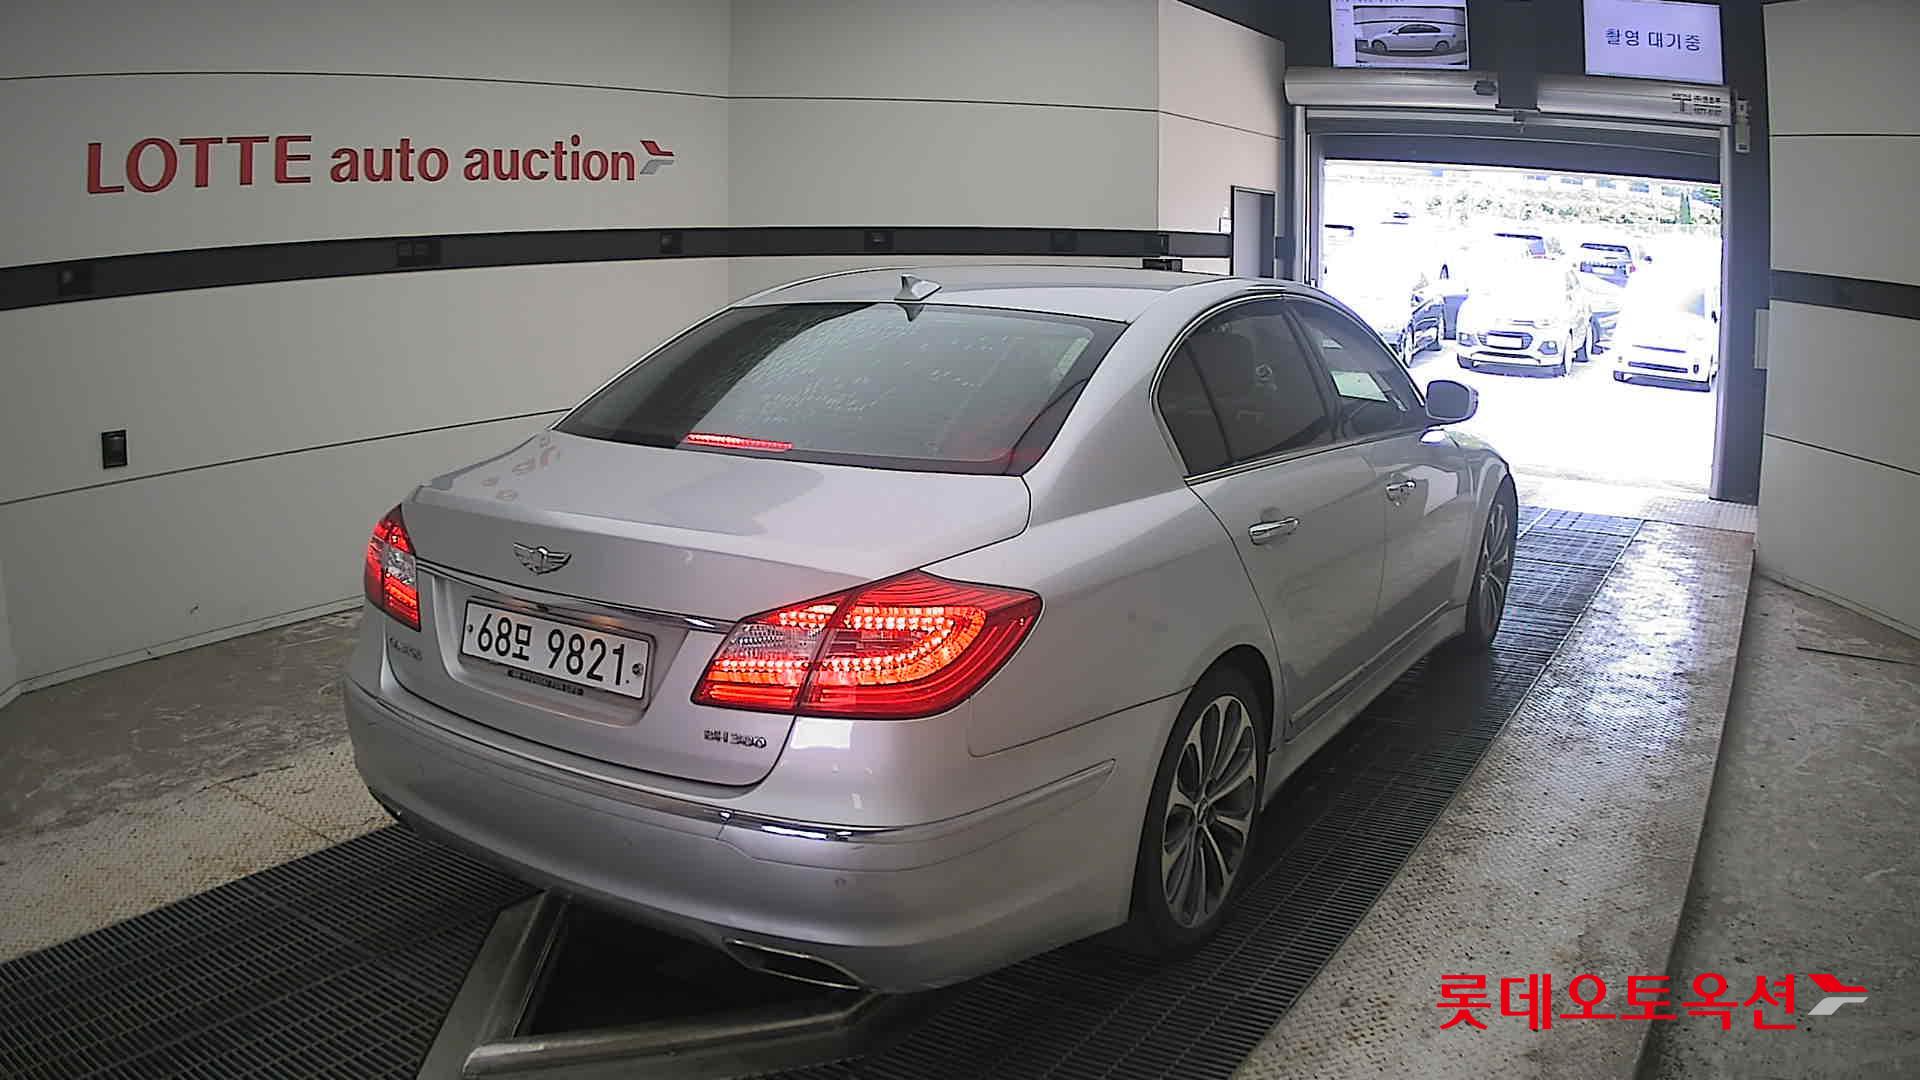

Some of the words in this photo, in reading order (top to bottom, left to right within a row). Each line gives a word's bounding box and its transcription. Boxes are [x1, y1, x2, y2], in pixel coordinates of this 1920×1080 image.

[1606, 28, 1640, 47] 촬영
[1647, 31, 1701, 51] 대기중
[87, 135, 312, 194] LOTTE
[329, 138, 449, 182] auto
[462, 134, 635, 181] auction
[477, 613, 531, 661] 68모
[547, 628, 625, 686] 9821
